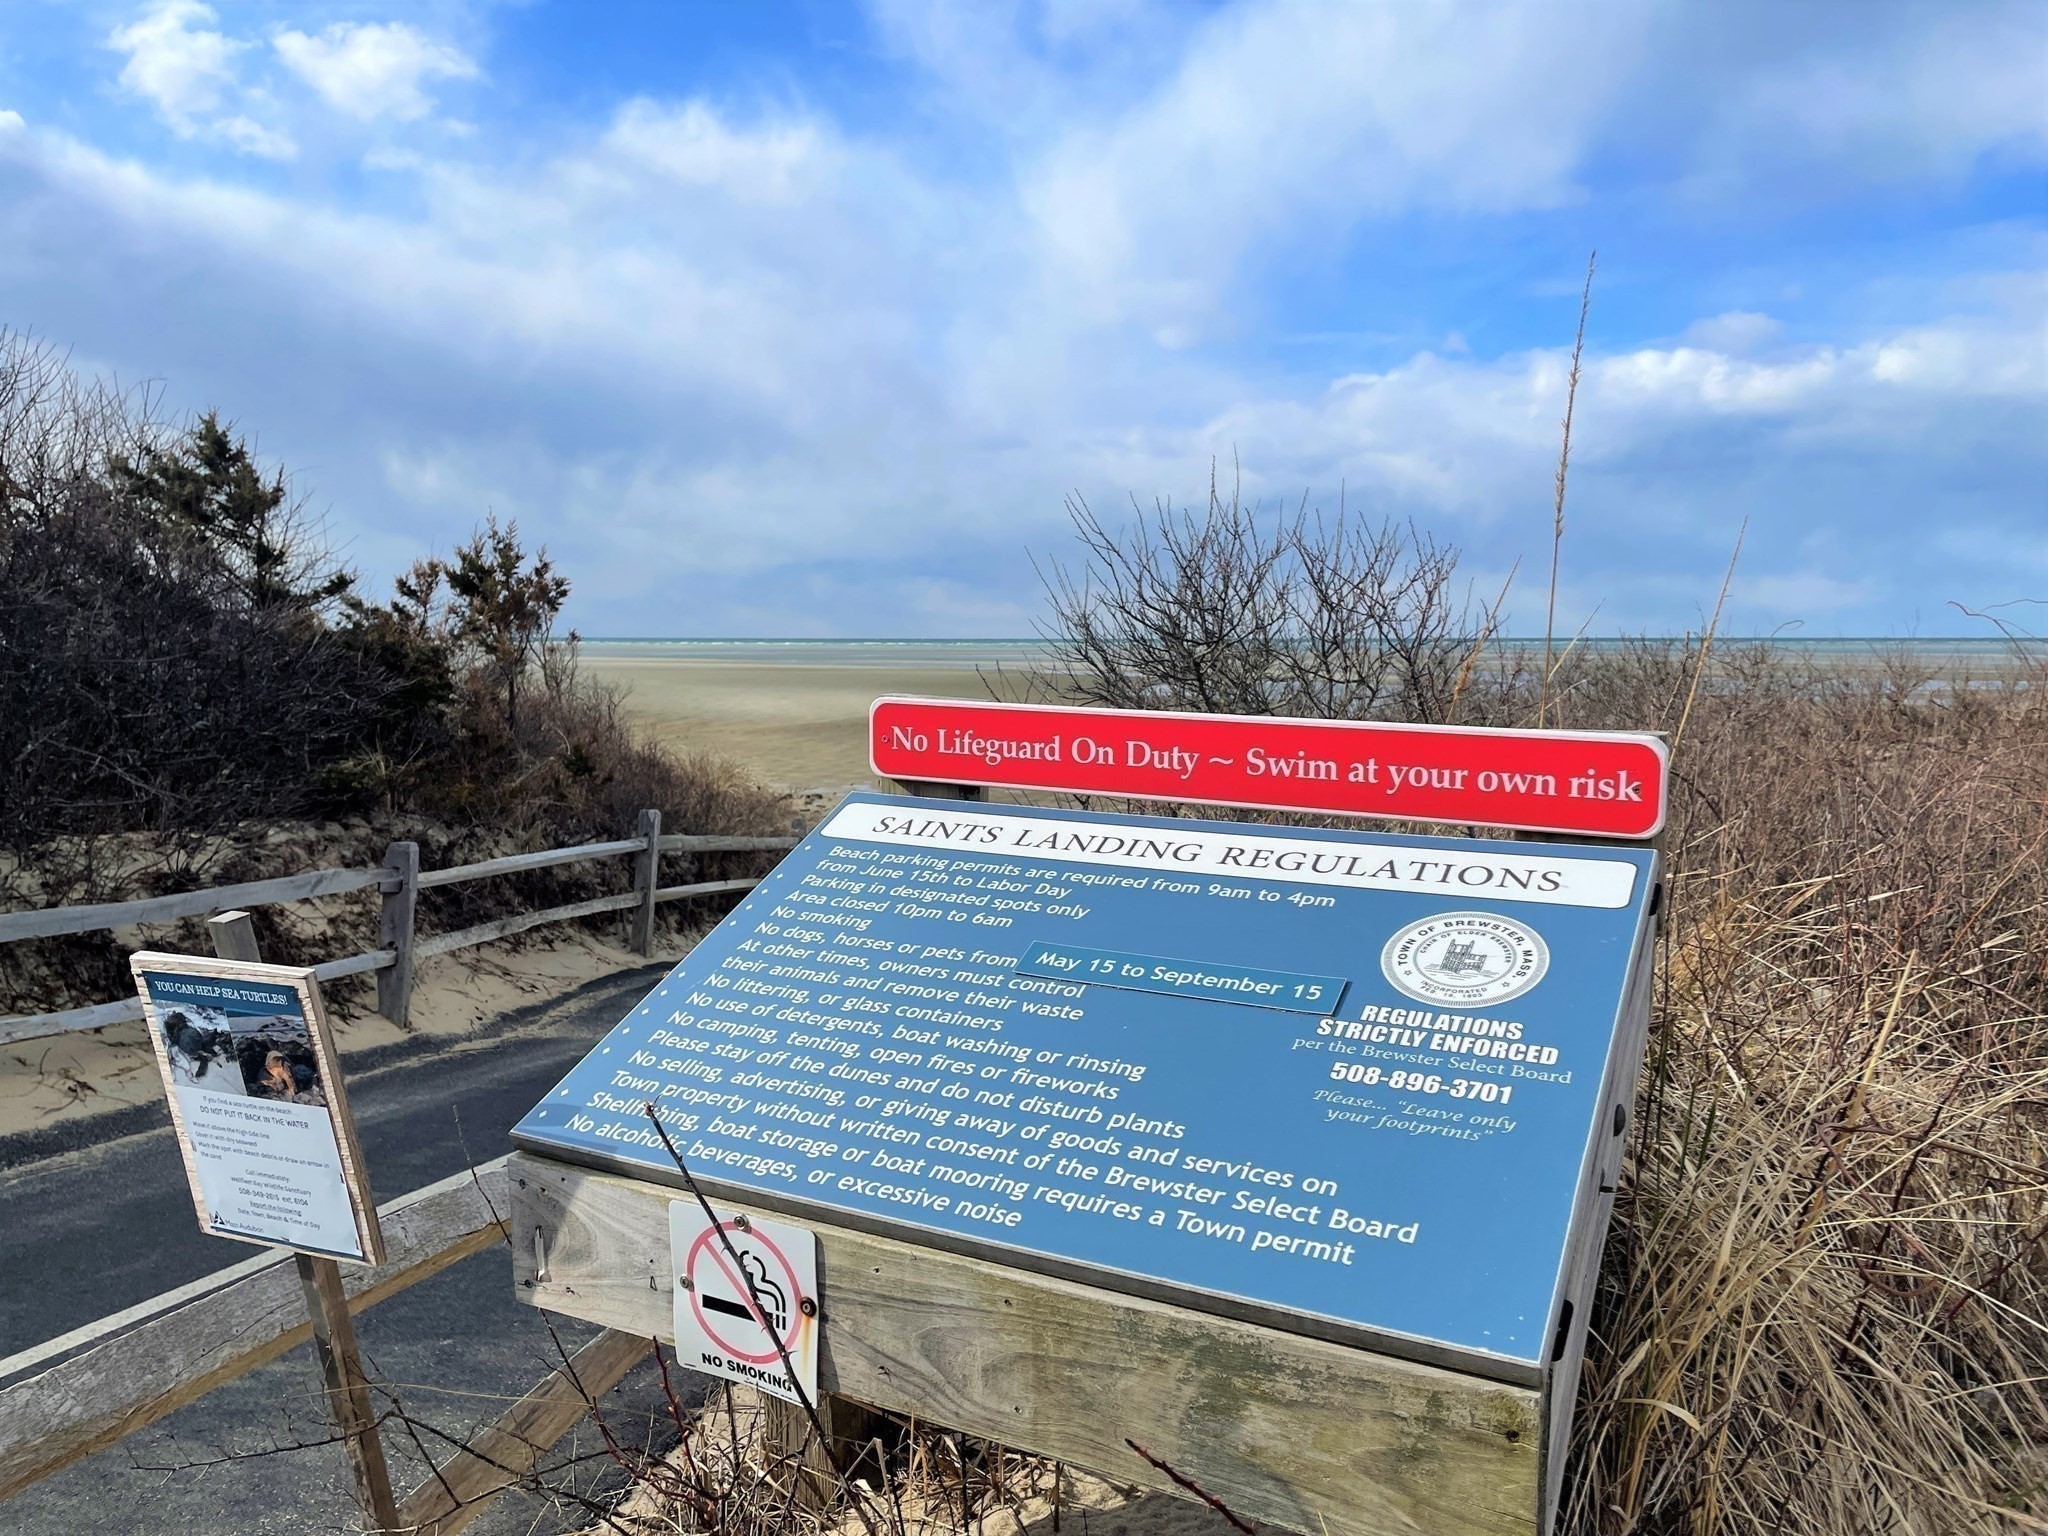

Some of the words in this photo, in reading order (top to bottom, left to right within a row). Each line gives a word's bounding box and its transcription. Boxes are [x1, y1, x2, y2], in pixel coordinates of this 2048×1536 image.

[891, 725, 928, 752] No
[937, 728, 1062, 766] Lifeguard
[1071, 737, 1116, 765] On
[1125, 740, 1200, 780] Duty
[1246, 747, 1339, 781] Swim
[1347, 757, 1379, 784] at
[1386, 765, 1469, 795] your
[1477, 771, 1558, 796] own
[1568, 768, 1631, 801] risk
[828, 845, 881, 861] Beach
[879, 853, 950, 871] parking
[948, 861, 1022, 876] permits
[1024, 868, 1058, 880] are
[1060, 872, 1149, 889] required
[1151, 878, 1201, 894] from
[1208, 883, 1252, 899] 9am
[1257, 889, 1281, 902] to
[1286, 891, 1336, 908] 4pm
[872, 816, 1004, 844] SAINTS
[1012, 829, 1203, 862] LANDING
[1217, 846, 1562, 892] REGULATIONS
[769, 905, 796, 919] No
[797, 911, 873, 932] smoking
[784, 889, 828, 905] Area
[830, 895, 891, 912] closed
[893, 902, 943, 919] 10pm
[946, 909, 968, 922] to
[972, 912, 1013, 928] 6am
[800, 874, 867, 894] Parking
[867, 881, 886, 894] in
[889, 884, 991, 906] designated
[990, 898, 1042, 912] spots
[1046, 904, 1091, 920] only
[736, 938, 762, 952] At
[762, 943, 815, 959] other
[816, 950, 871, 971] times,
[878, 960, 950, 979] owners
[952, 971, 1005, 987] must
[1008, 978, 1087, 998] control
[753, 921, 781, 935] No
[782, 925, 826, 945] dogs,
[832, 931, 895, 951] horses
[897, 943, 922, 954] or
[919, 946, 966, 961] pets
[969, 950, 1018, 968] from
[1398, 938, 1417, 966] TOWN
[1418, 925, 1436, 937] OF
[1444, 920, 1525, 946] BREWSTER,
[1512, 949, 1534, 978] MASS.
[154, 980, 175, 992] YOU
[174, 982, 195, 994] CAN
[194, 984, 221, 997] HELP
[221, 987, 240, 1000] SEA
[239, 990, 288, 1005] TURTLES!
[1034, 951, 1082, 972] May
[1089, 958, 1117, 973] 15
[1120, 963, 1145, 978] to
[1150, 966, 1284, 995] September
[1294, 984, 1323, 1000] 15
[703, 973, 731, 988] No
[732, 977, 810, 1004] littering,
[817, 993, 843, 1006] or
[840, 996, 892, 1014] glass
[894, 1005, 1004, 1031] containers
[1360, 1005, 1524, 1040] REGULATIONS
[666, 1010, 695, 1027] No
[696, 1018, 778, 1045] camping,
[786, 1031, 861, 1059] tenting,
[869, 1047, 923, 1066] open
[926, 1053, 977, 1075] fires
[980, 1066, 1008, 1080] or
[1010, 1067, 1120, 1100] fireworks
[1291, 1038, 1324, 1050] per
[1328, 1040, 1357, 1055] the
[1360, 1044, 1444, 1066] Brewster
[1447, 1056, 1505, 1075] Select
[1510, 1064, 1572, 1084] Board
[1316, 1018, 1428, 1048] STRICTLY
[1429, 1033, 1559, 1065] ENFORCED
[1330, 1061, 1512, 1105] 508-896-3701
[199, 1105, 209, 1114] DO
[209, 1107, 222, 1115] NOT
[223, 1109, 236, 1118] PUT
[236, 1111, 243, 1119] IT
[243, 1112, 262, 1122] BACK
[271, 1116, 285, 1126] THE
[285, 1119, 309, 1129] WATER
[627, 1049, 657, 1067] No
[656, 1058, 724, 1084] selling,
[729, 1071, 846, 1107] advertising,
[854, 1095, 883, 1109] or
[880, 1098, 952, 1127] giving
[953, 1113, 1017, 1138] away
[1020, 1124, 1051, 1141] of
[1047, 1131, 1123, 1156] goods
[1127, 1145, 1180, 1166] and
[1181, 1155, 1294, 1188] services
[1302, 1177, 1338, 1197] on
[1324, 1109, 1374, 1123] your
[1469, 1115, 1517, 1134] only
[564, 1113, 595, 1133] No
[686, 1139, 798, 1183] beverages,
[807, 1169, 836, 1185] or
[837, 1176, 951, 1211] excessive
[954, 1200, 1022, 1227] noise
[585, 1091, 700, 1132] Shellfihing,
[706, 1115, 758, 1140] boat
[757, 1129, 839, 1158] storage
[841, 1147, 871, 1163] or
[870, 1148, 927, 1176] boat
[927, 1164, 1030, 1201] mooring
[1032, 1186, 1143, 1221] requires
[1148, 1209, 1166, 1226] a
[1176, 1209, 1246, 1243] Town
[1250, 1230, 1355, 1265] permit
[610, 1069, 660, 1093] Town
[658, 1083, 752, 1114] property
[753, 1101, 837, 1129] without
[839, 1118, 921, 1146] written
[925, 1136, 1020, 1165] consent
[1023, 1153, 1055, 1171] of
[1055, 1157, 1099, 1181] the
[1104, 1166, 1227, 1205] Brewster
[1231, 1190, 1321, 1225] Select
[1328, 1208, 1419, 1244] Board
[702, 1353, 722, 1368] NO
[727, 1360, 793, 1392] SMOKING
